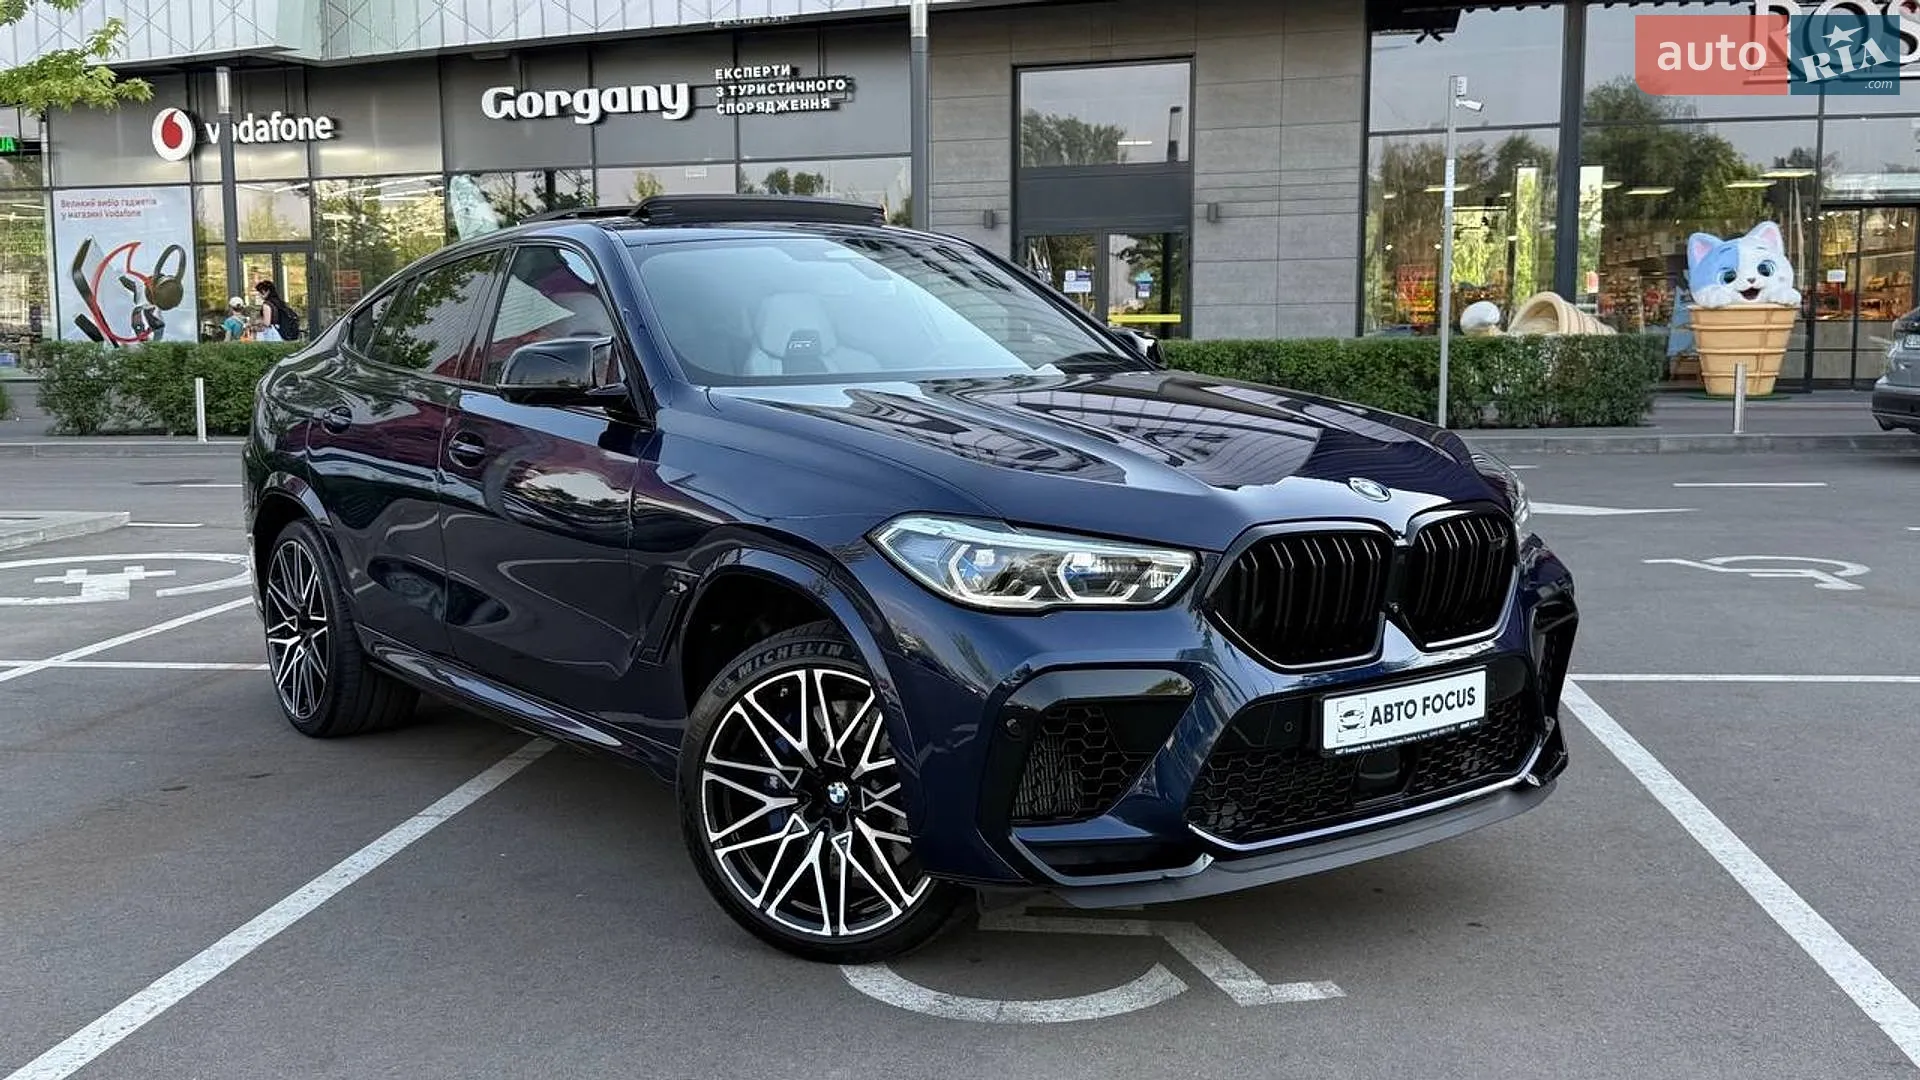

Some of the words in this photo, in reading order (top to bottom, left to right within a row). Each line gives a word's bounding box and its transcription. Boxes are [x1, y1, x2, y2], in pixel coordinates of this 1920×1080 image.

[715, 64, 791, 80] ЕКСПЕРТИ
[728, 79, 846, 96] ТУРИСТИЧНОГО
[481, 83, 690, 124] Gorgany
[716, 98, 831, 114] СПОРЯДЖЕННЯ
[738, 642, 844, 678] MICHELIN
[1370, 699, 1417, 727] АВТО
[1422, 686, 1476, 716] FOCUS
